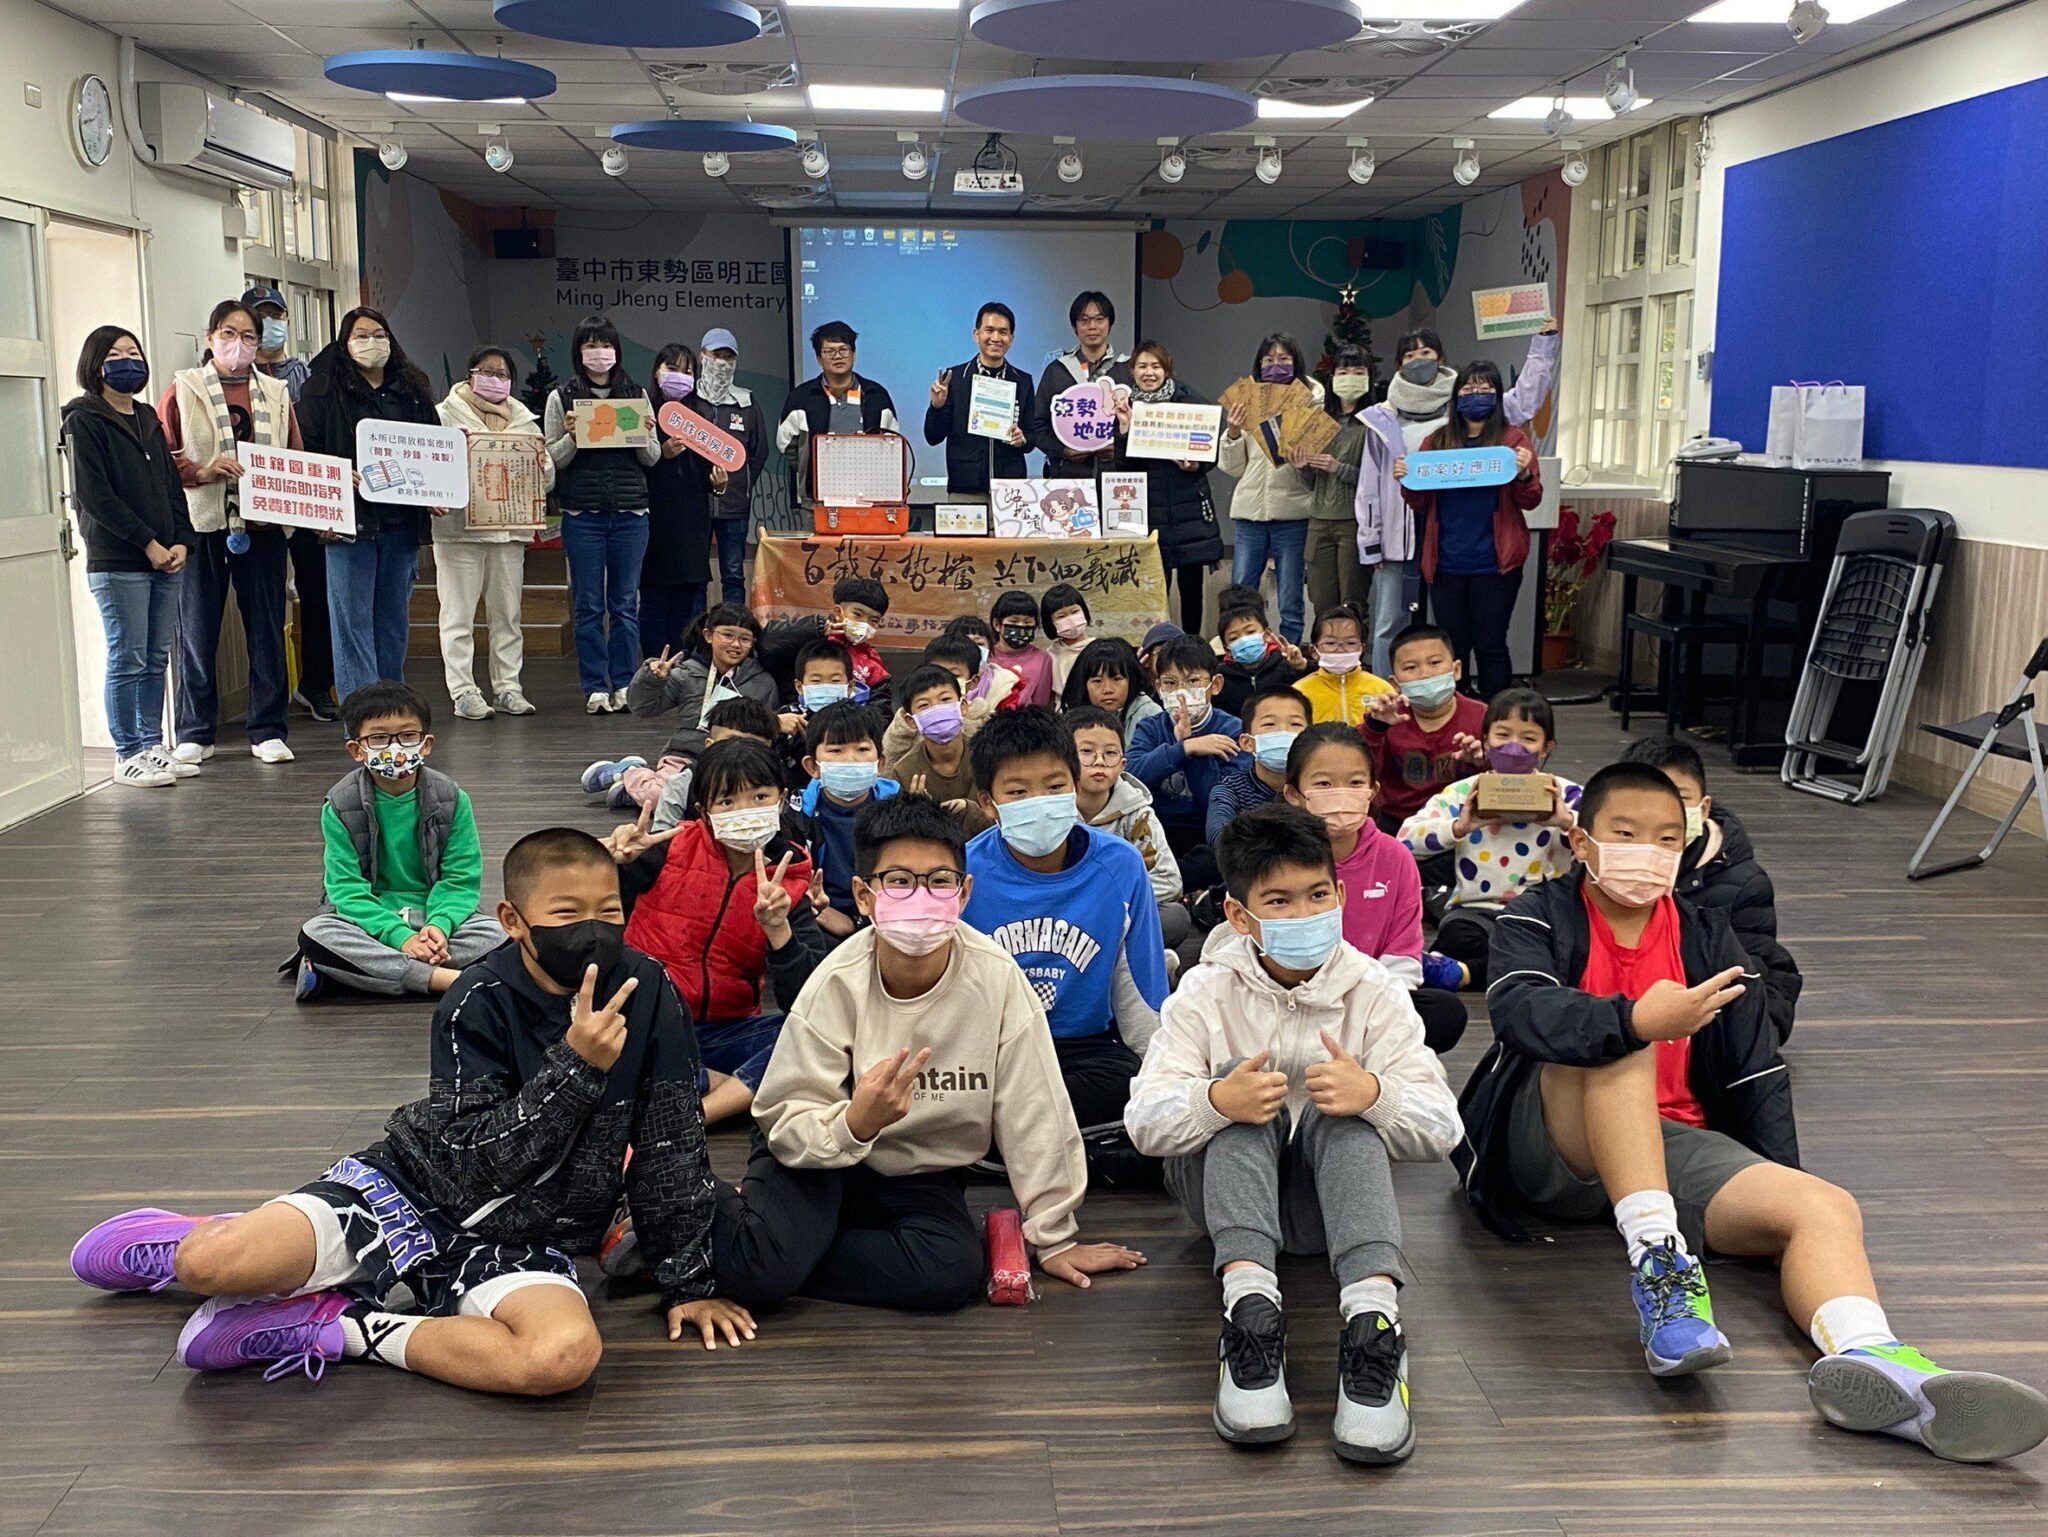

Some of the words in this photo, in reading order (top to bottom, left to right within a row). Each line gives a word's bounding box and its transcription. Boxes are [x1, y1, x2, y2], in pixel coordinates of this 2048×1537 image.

[557, 288, 603, 310] Ming
[611, 290, 668, 311] Jheng
[676, 291, 785, 312] Elementary
[369, 432, 454, 449] 本所已開放檔案應用
[668, 412, 735, 462] 防詐保房產
[250, 452, 341, 481] 地籍圖重測
[1416, 458, 1501, 478] 檔案好應用
[251, 474, 342, 501] 通知協助指界
[986, 917, 1101, 974] ORNAGAIN
[1020, 968, 1067, 981] YSBABY
[912, 1066, 988, 1091] ntain
[914, 1093, 927, 1102] OF
[931, 1093, 945, 1102] ME
